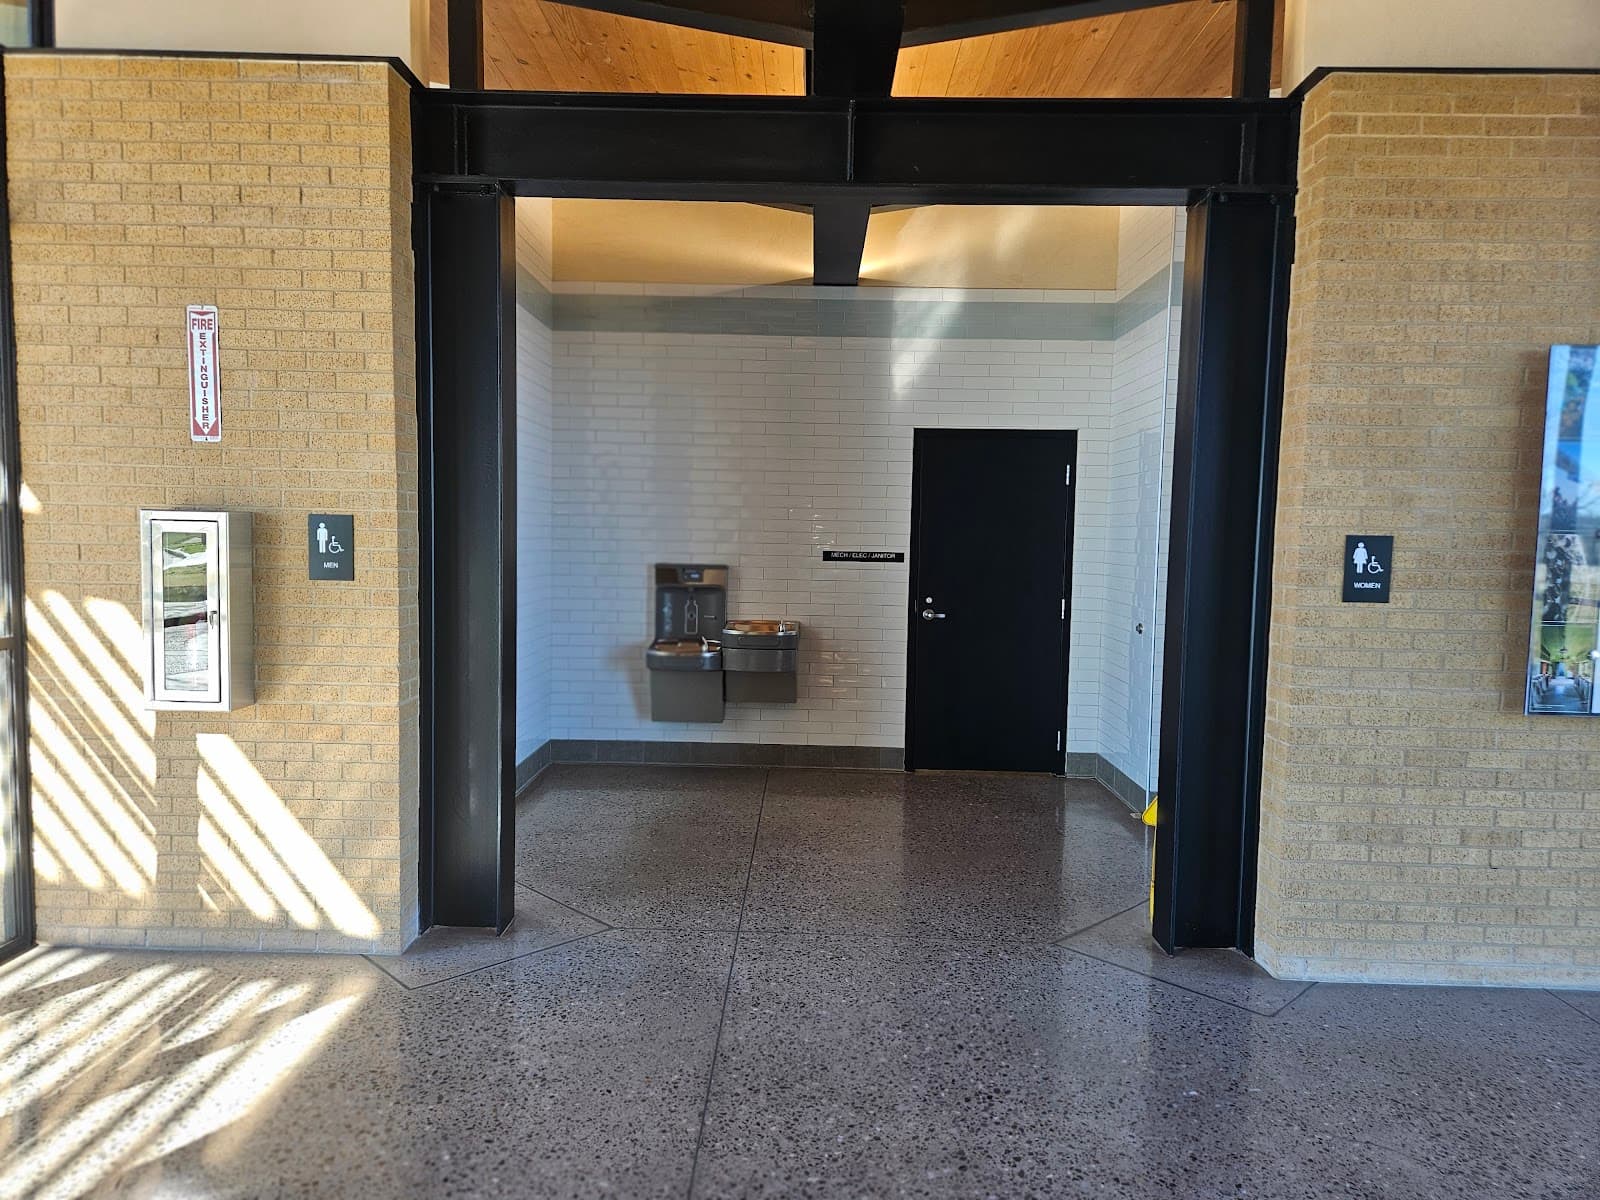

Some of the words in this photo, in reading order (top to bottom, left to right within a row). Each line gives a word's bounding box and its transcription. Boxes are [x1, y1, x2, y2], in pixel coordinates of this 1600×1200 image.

[192, 318, 213, 330] FIRE
[199, 333, 210, 429] EXTINGUISHER
[323, 561, 339, 569] MEN
